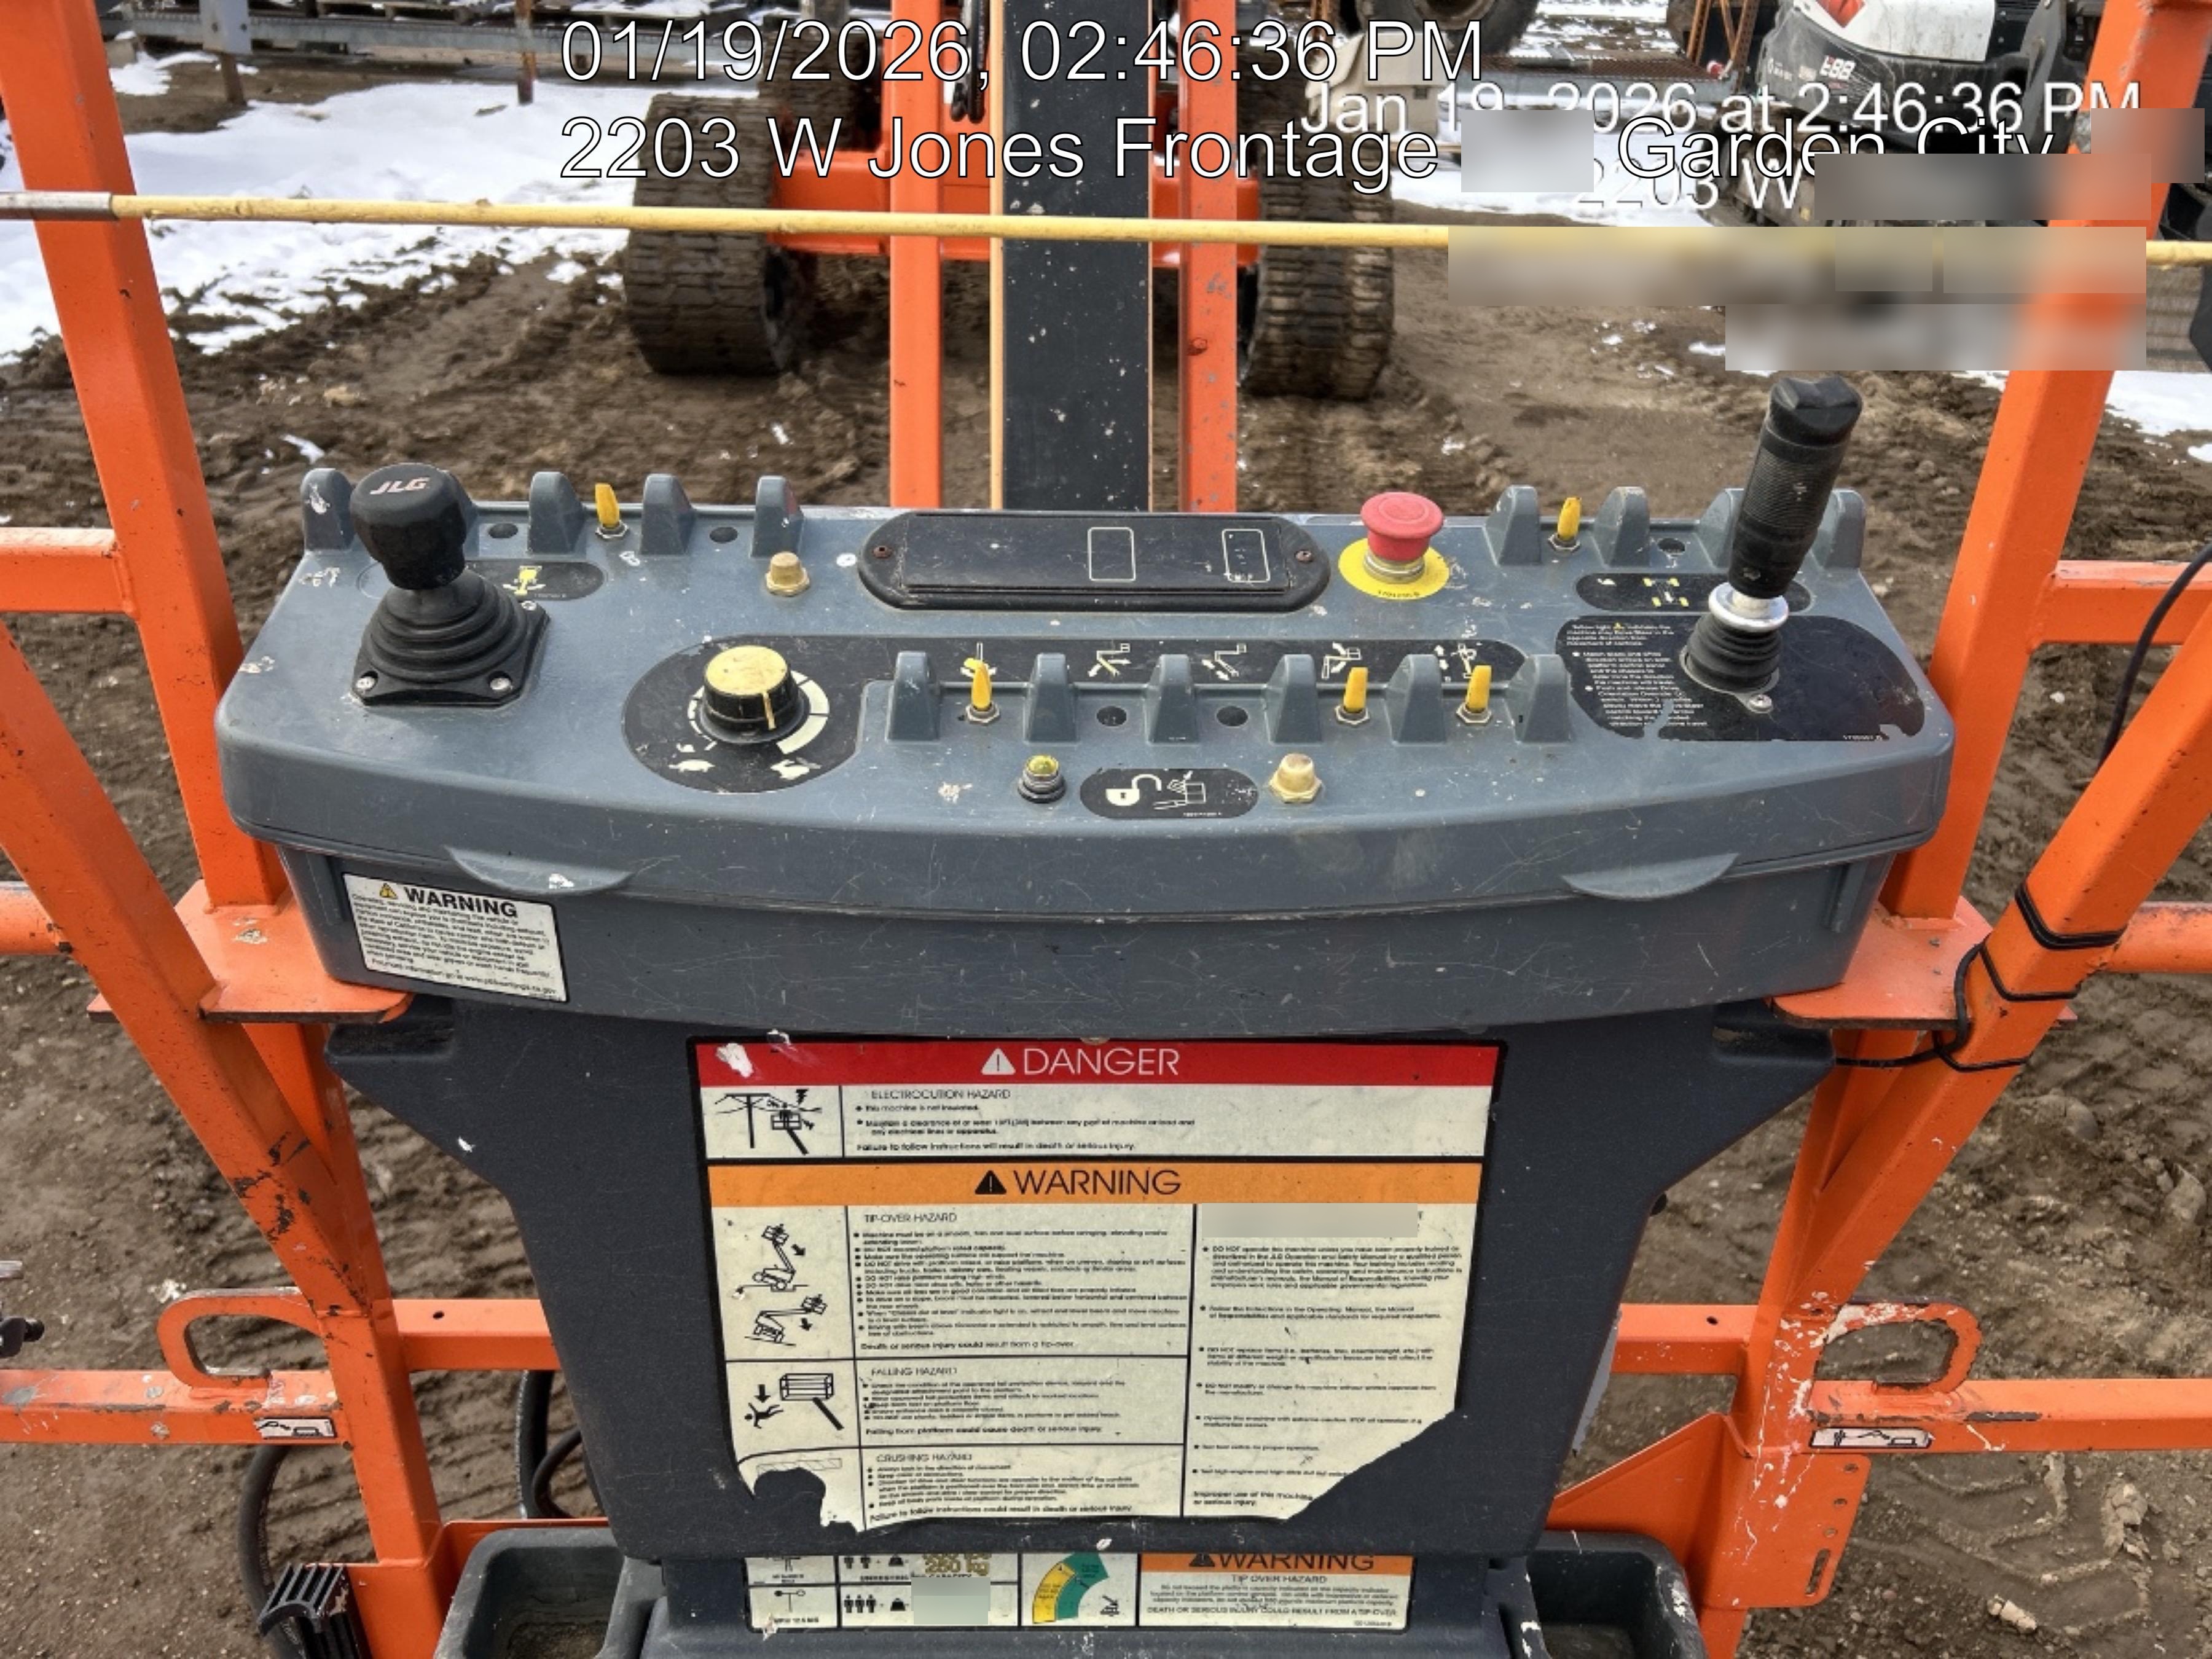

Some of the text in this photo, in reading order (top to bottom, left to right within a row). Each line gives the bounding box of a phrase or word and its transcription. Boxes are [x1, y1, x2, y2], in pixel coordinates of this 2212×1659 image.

[370, 477, 429, 495] JLG
[403, 886, 518, 918] WARNING
[1024, 1048, 1180, 1075] DANGER
[871, 1089, 1011, 1099] ELECTROCUTION HAZARD
[1013, 1169, 1182, 1195] WARNING
[865, 1213, 957, 1223] TIP-OVER HAZARD
[871, 1367, 912, 1376] FALLING
[1220, 1555, 1375, 1571] WARNING
